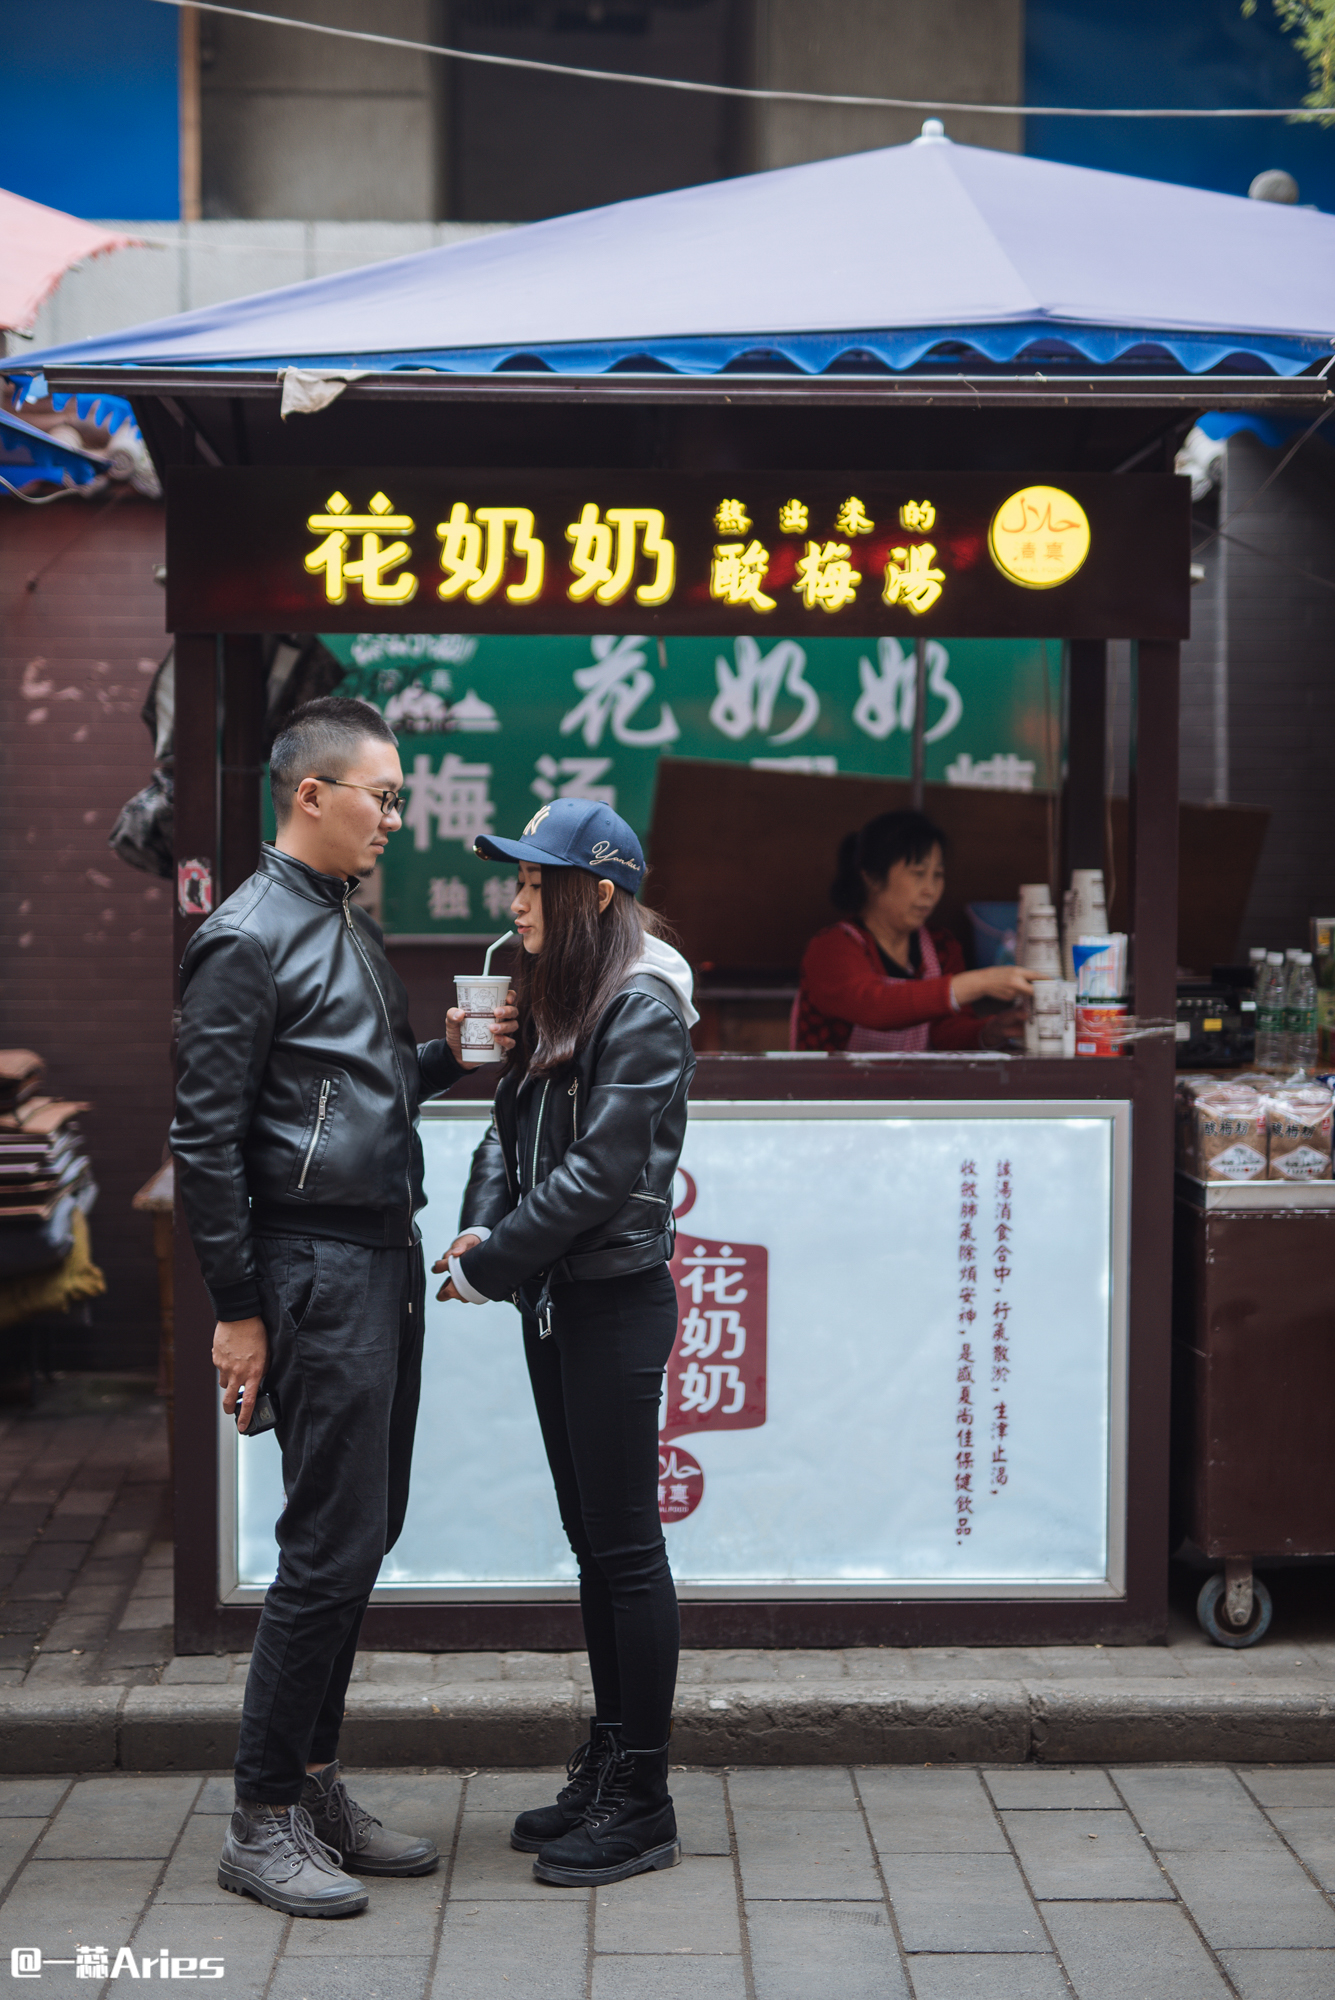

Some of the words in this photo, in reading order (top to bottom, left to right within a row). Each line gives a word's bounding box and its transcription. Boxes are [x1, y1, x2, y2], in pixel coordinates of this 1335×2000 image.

[303, 490, 677, 606] 花奶奶
[713, 496, 938, 537] 熬出來的
[1001, 497, 1081, 533] حلال
[711, 539, 946, 615] 酸梅湯
[558, 636, 963, 745] 花奶奶
[1203, 1120, 1249, 1137] 酸梅粉
[679, 1245, 749, 1414] 花奶奶
